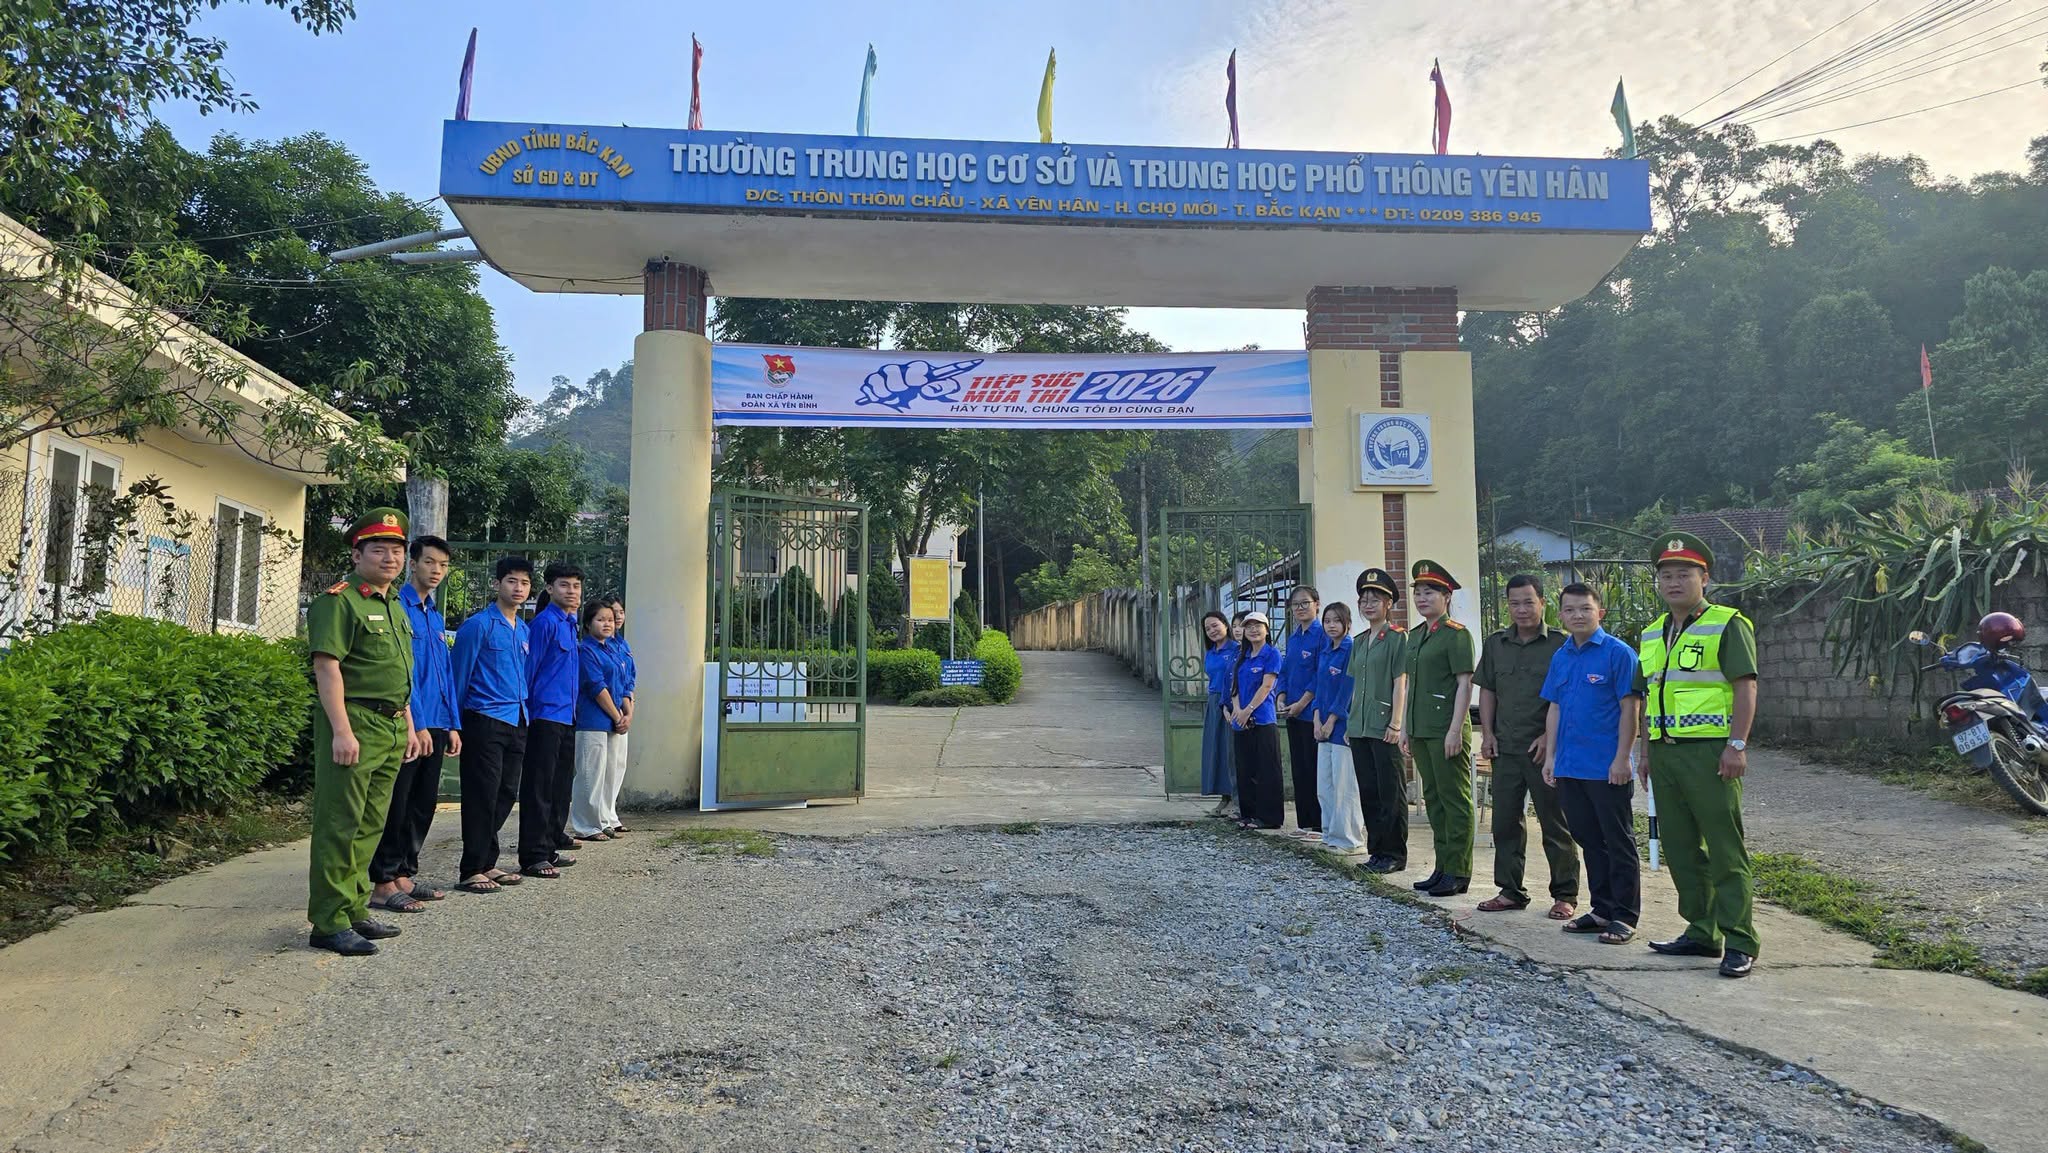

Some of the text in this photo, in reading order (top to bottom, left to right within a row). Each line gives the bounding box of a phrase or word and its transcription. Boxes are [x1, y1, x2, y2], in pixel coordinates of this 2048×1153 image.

[479, 128, 634, 178] UBND TỈNH BẮC KẠN
[512, 163, 599, 186] SỞ GD & ĐT
[669, 137, 1609, 200] TRƯỜNG TRUNG HỌC CƠ SỞ VÀ TRUNG HỌC PHỔ THÔNG YÊN HÂN
[745, 188, 784, 202] Đ/C:
[789, 188, 844, 206] THÔN
[850, 191, 905, 207] THÔM
[980, 194, 1010, 211] XÃ
[1014, 196, 1052, 212] YÊN
[1058, 197, 1099, 213] HÂN
[1114, 201, 1132, 214] H.
[1137, 202, 1176, 218] CHỢ
[1183, 200, 1218, 216] MỚI
[1234, 204, 1250, 216] T.
[1256, 198, 1293, 217] BẮC
[1299, 206, 1341, 222] KẠN
[1384, 208, 1415, 220] ĐT:
[1419, 209, 1464, 221] 0209
[1469, 211, 1503, 222] 386
[1508, 211, 1542, 223] 945
[970, 371, 1086, 389] TIẾP SỨC
[1077, 370, 1204, 401] 2026
[746, 391, 813, 401] BAN CHẤP HÀNH
[1026, 389, 1073, 404] THI
[983, 405, 1001, 415] TỰ
[1004, 406, 1028, 415] TIN,
[1032, 405, 1082, 414] CHÚNG
[1085, 405, 1105, 414] TÔI
[1108, 406, 1125, 414] ĐI
[1126, 405, 1163, 414] CÙNG
[1167, 406, 1195, 416] BẠN
[1958, 732, 1989, 753] 069.56
